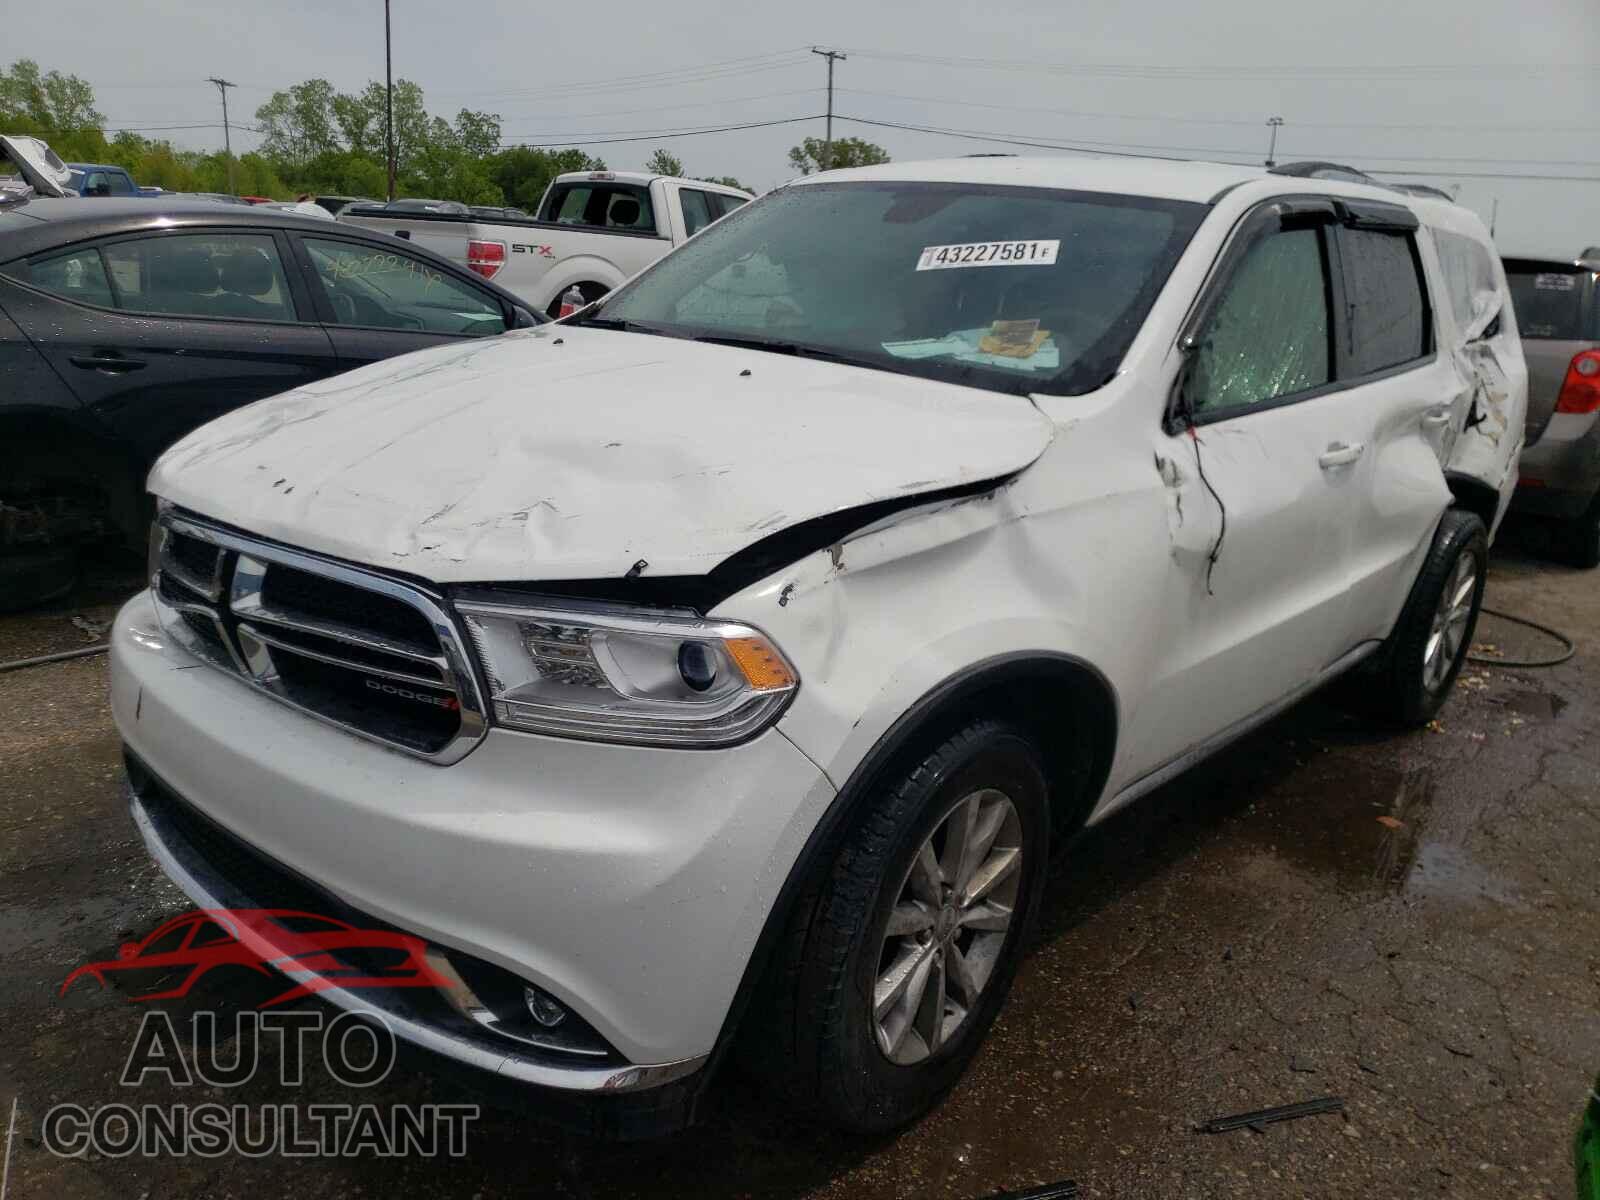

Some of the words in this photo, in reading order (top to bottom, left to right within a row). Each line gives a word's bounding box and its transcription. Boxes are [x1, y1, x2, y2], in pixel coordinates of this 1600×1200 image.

[511, 243, 552, 255] STX
[936, 242, 1038, 264] 43227581
[366, 679, 449, 708] DODGE
